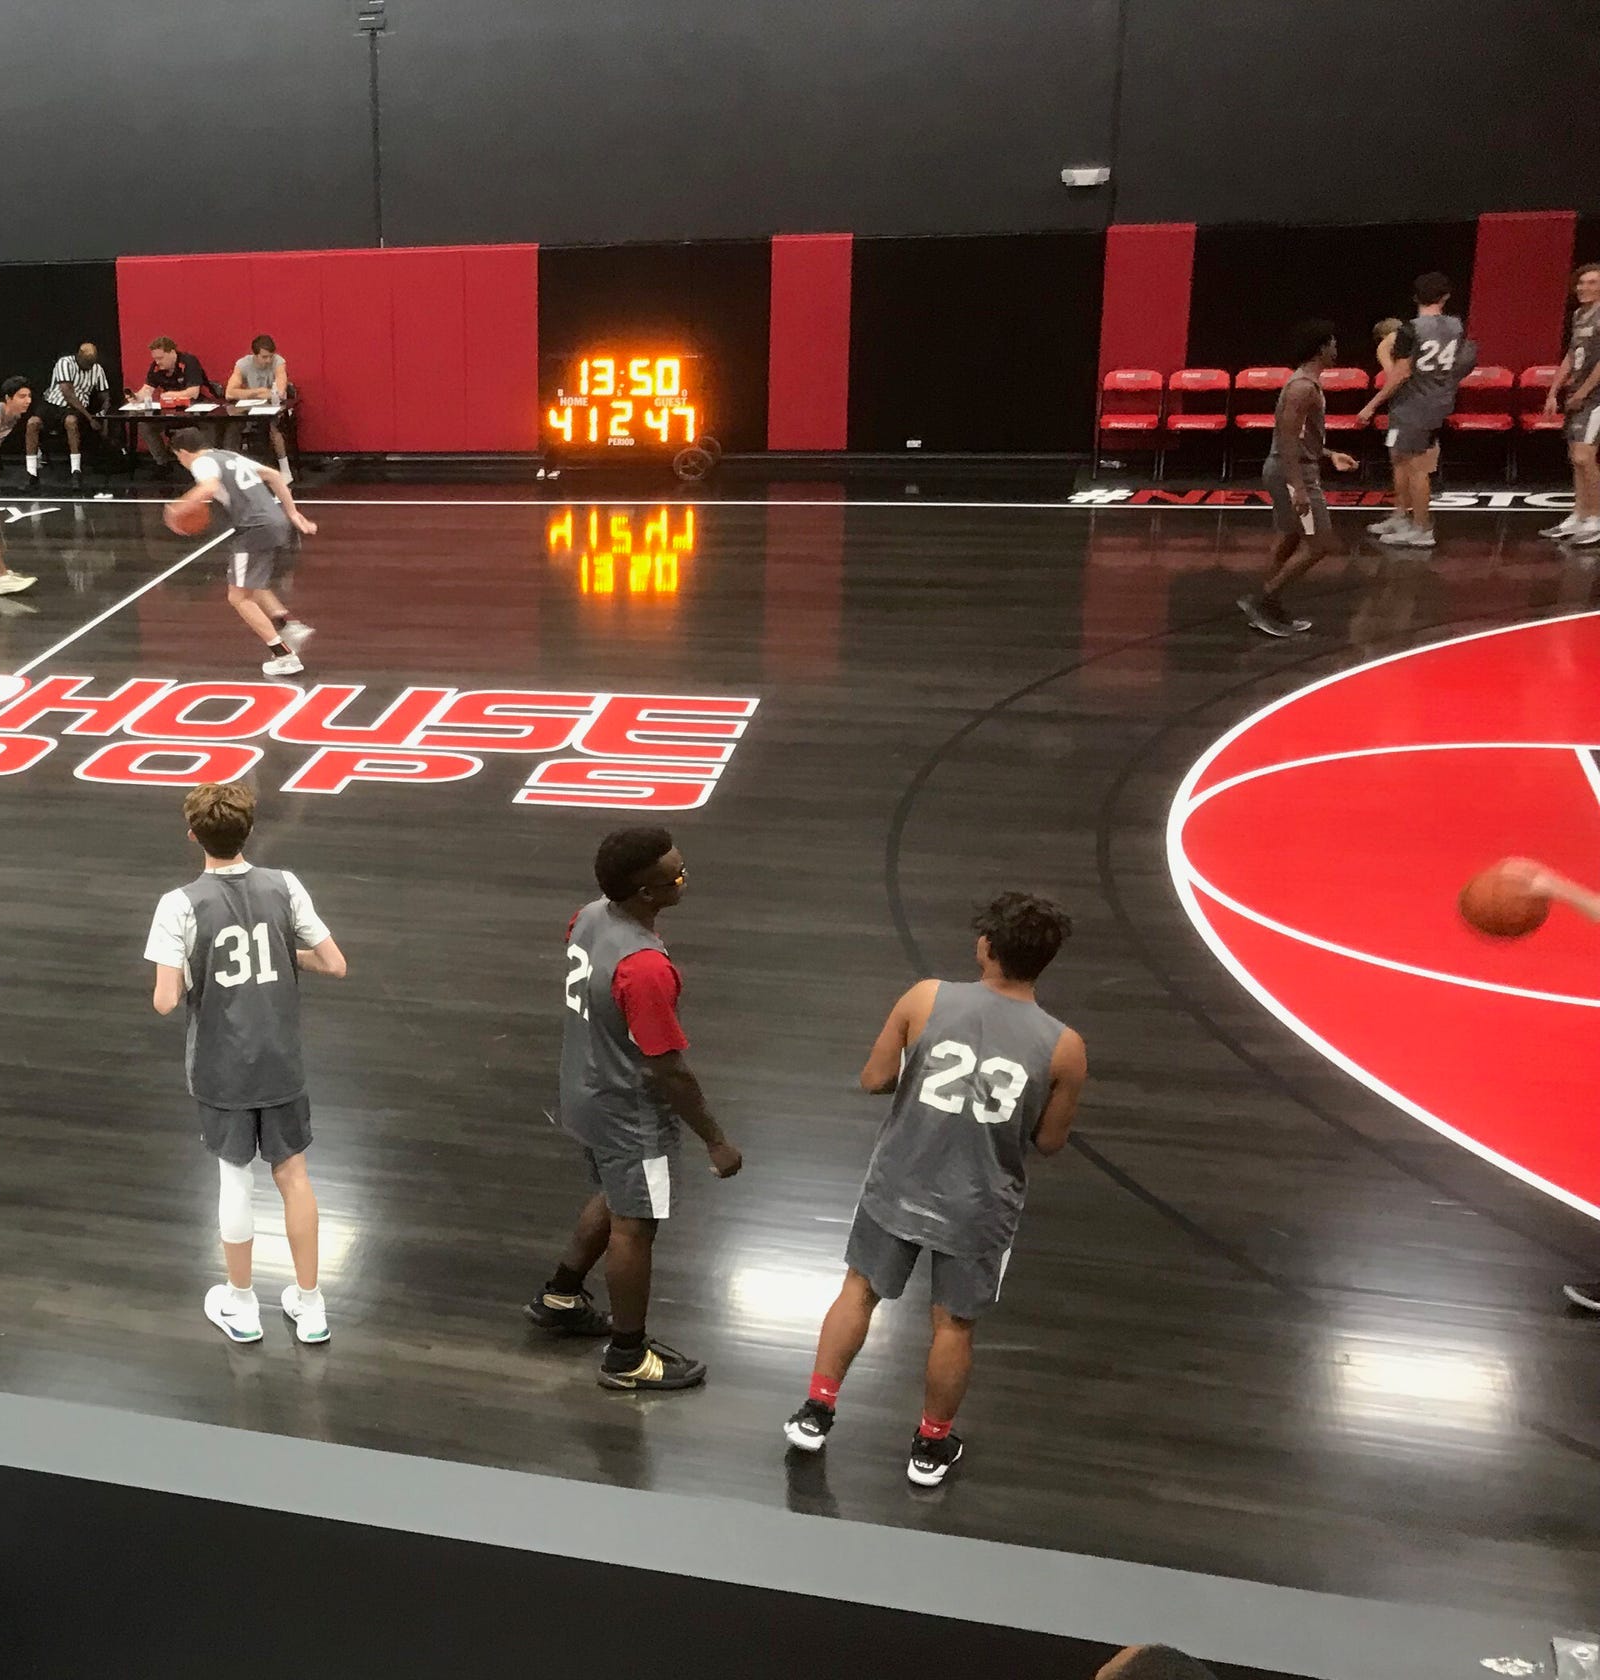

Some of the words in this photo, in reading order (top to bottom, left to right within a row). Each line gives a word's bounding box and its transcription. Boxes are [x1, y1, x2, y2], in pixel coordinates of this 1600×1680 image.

[1416, 339, 1458, 372] 24
[579, 358, 681, 396] 13:50
[559, 397, 590, 407] HOME
[653, 397, 688, 407] GUEST
[609, 401, 634, 436] 2
[644, 406, 697, 443] 47
[607, 438, 636, 447] PERIOD
[213, 922, 280, 988] 31
[565, 943, 593, 1022] 2
[918, 1039, 1029, 1125] 23
